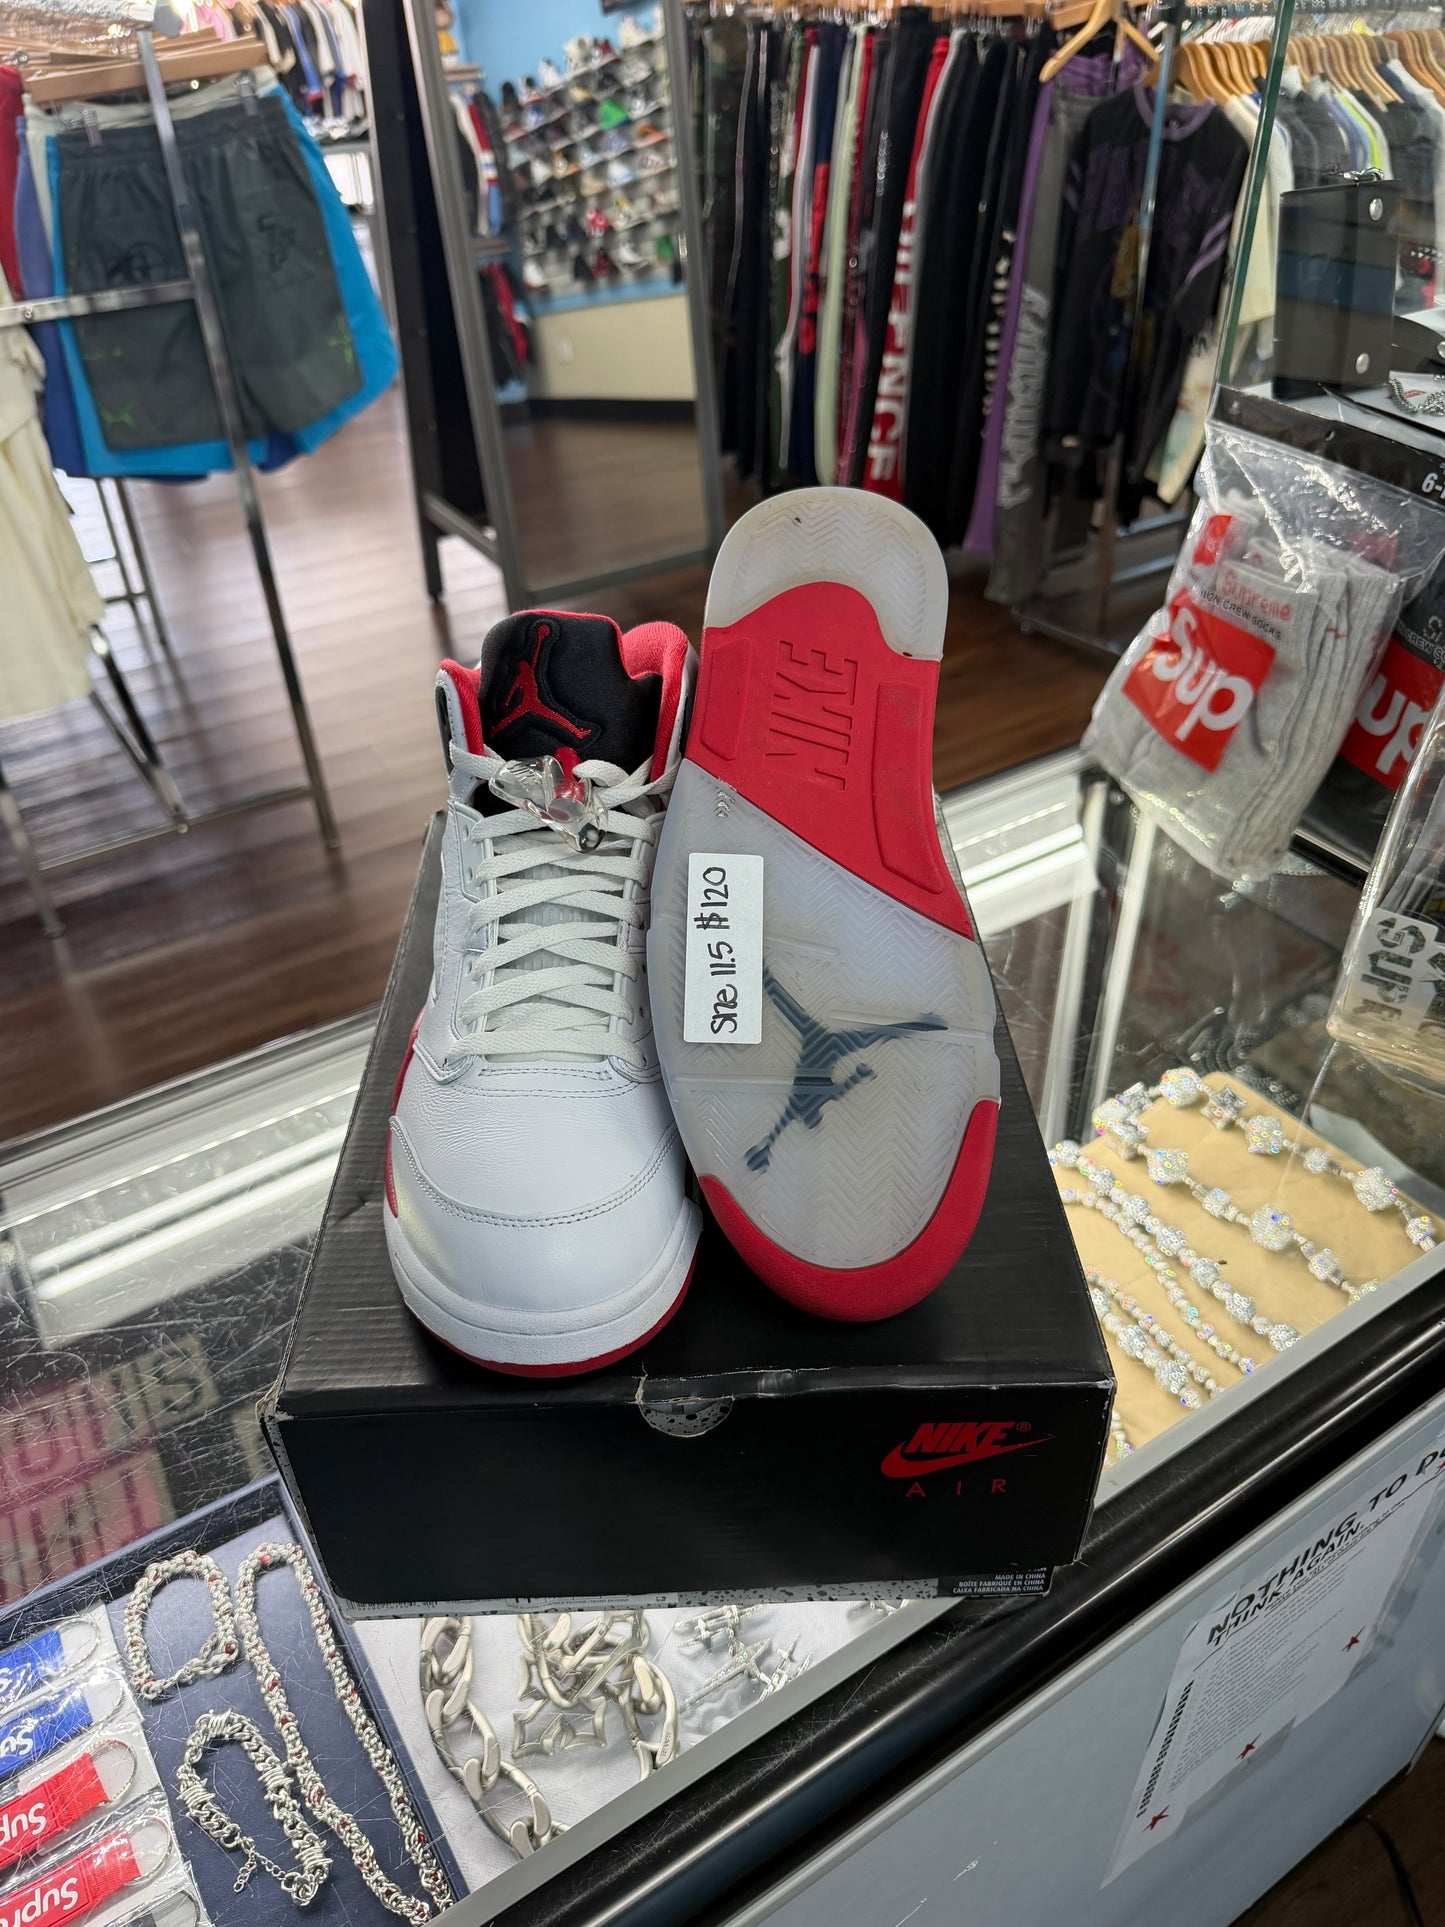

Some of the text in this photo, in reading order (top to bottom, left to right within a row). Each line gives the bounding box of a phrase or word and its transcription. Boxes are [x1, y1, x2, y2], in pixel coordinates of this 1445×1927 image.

[1152, 607, 1254, 742] Sup
[762, 639, 859, 792] NIKE
[693, 866, 730, 930] $120
[707, 940, 737, 978] 11.5
[905, 1478, 1007, 1498] AIR
[1025, 1572, 1046, 1580] CHINA
[1206, 1511, 1358, 1645] NOTHING
[1368, 1473, 1408, 1513] TO
[1213, 1582, 1285, 1647] THINK
